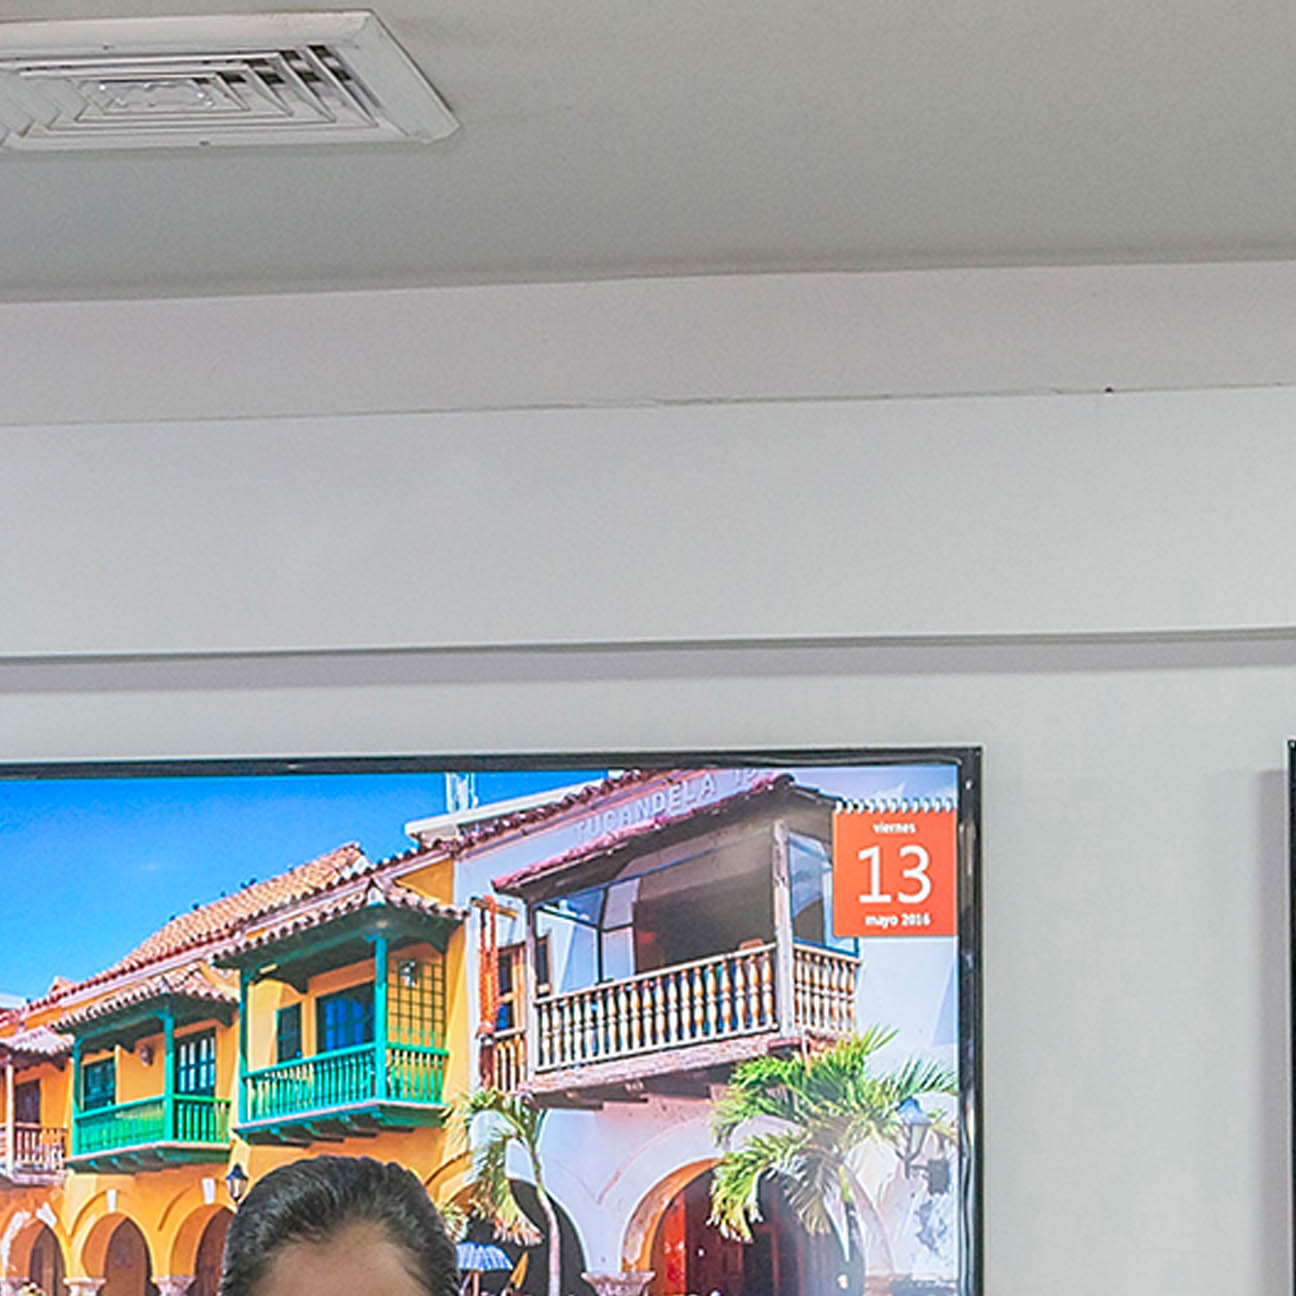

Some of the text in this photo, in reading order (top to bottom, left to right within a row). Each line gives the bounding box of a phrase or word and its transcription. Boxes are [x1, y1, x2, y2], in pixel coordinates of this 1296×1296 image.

[873, 820, 916, 834] viernes
[858, 845, 932, 903] 13
[865, 912, 931, 929] mayo 2016
